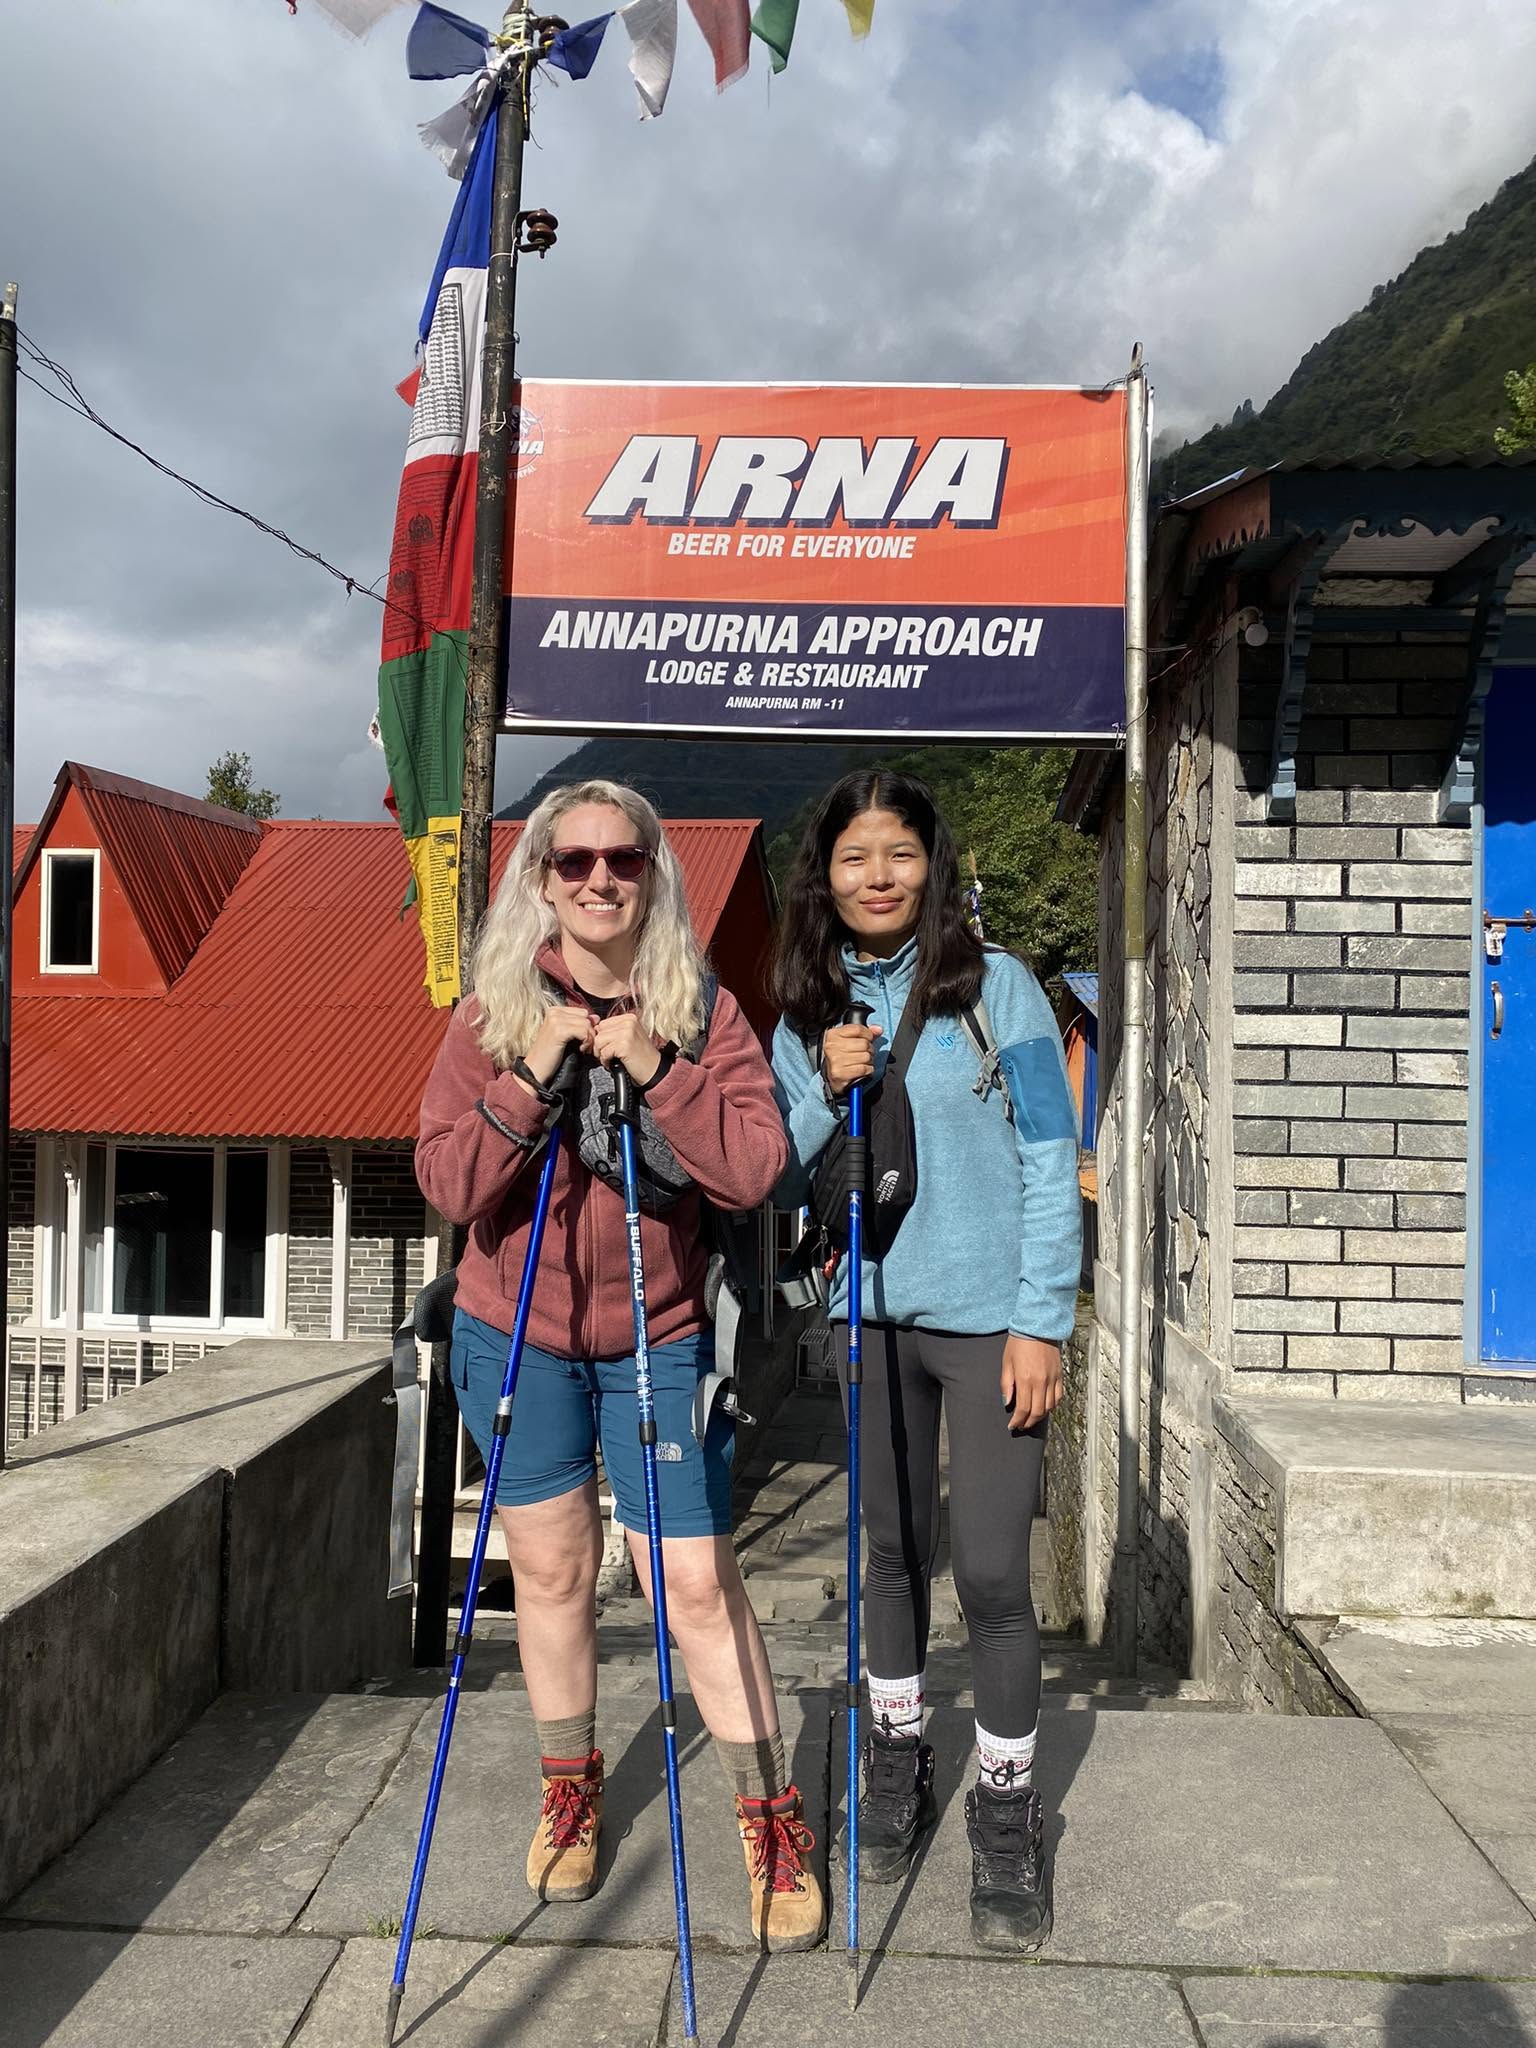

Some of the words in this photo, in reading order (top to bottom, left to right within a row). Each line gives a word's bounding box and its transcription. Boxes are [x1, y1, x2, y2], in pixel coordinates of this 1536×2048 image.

[583, 434, 1009, 527] ARNA
[667, 532, 730, 556] BEER
[736, 534, 785, 557] FOR
[790, 535, 917, 559] EVERYONE
[538, 609, 799, 654] ANNAPURNA
[806, 615, 1044, 657] APPROACH
[644, 659, 729, 686] LODGE
[733, 661, 755, 687] &
[760, 662, 930, 689] RESTAURANT
[724, 696, 799, 710] ANNAPURNA
[801, 697, 823, 710] RM
[823, 698, 845, 710] -11
[630, 1225, 645, 1301] BUFFALO
